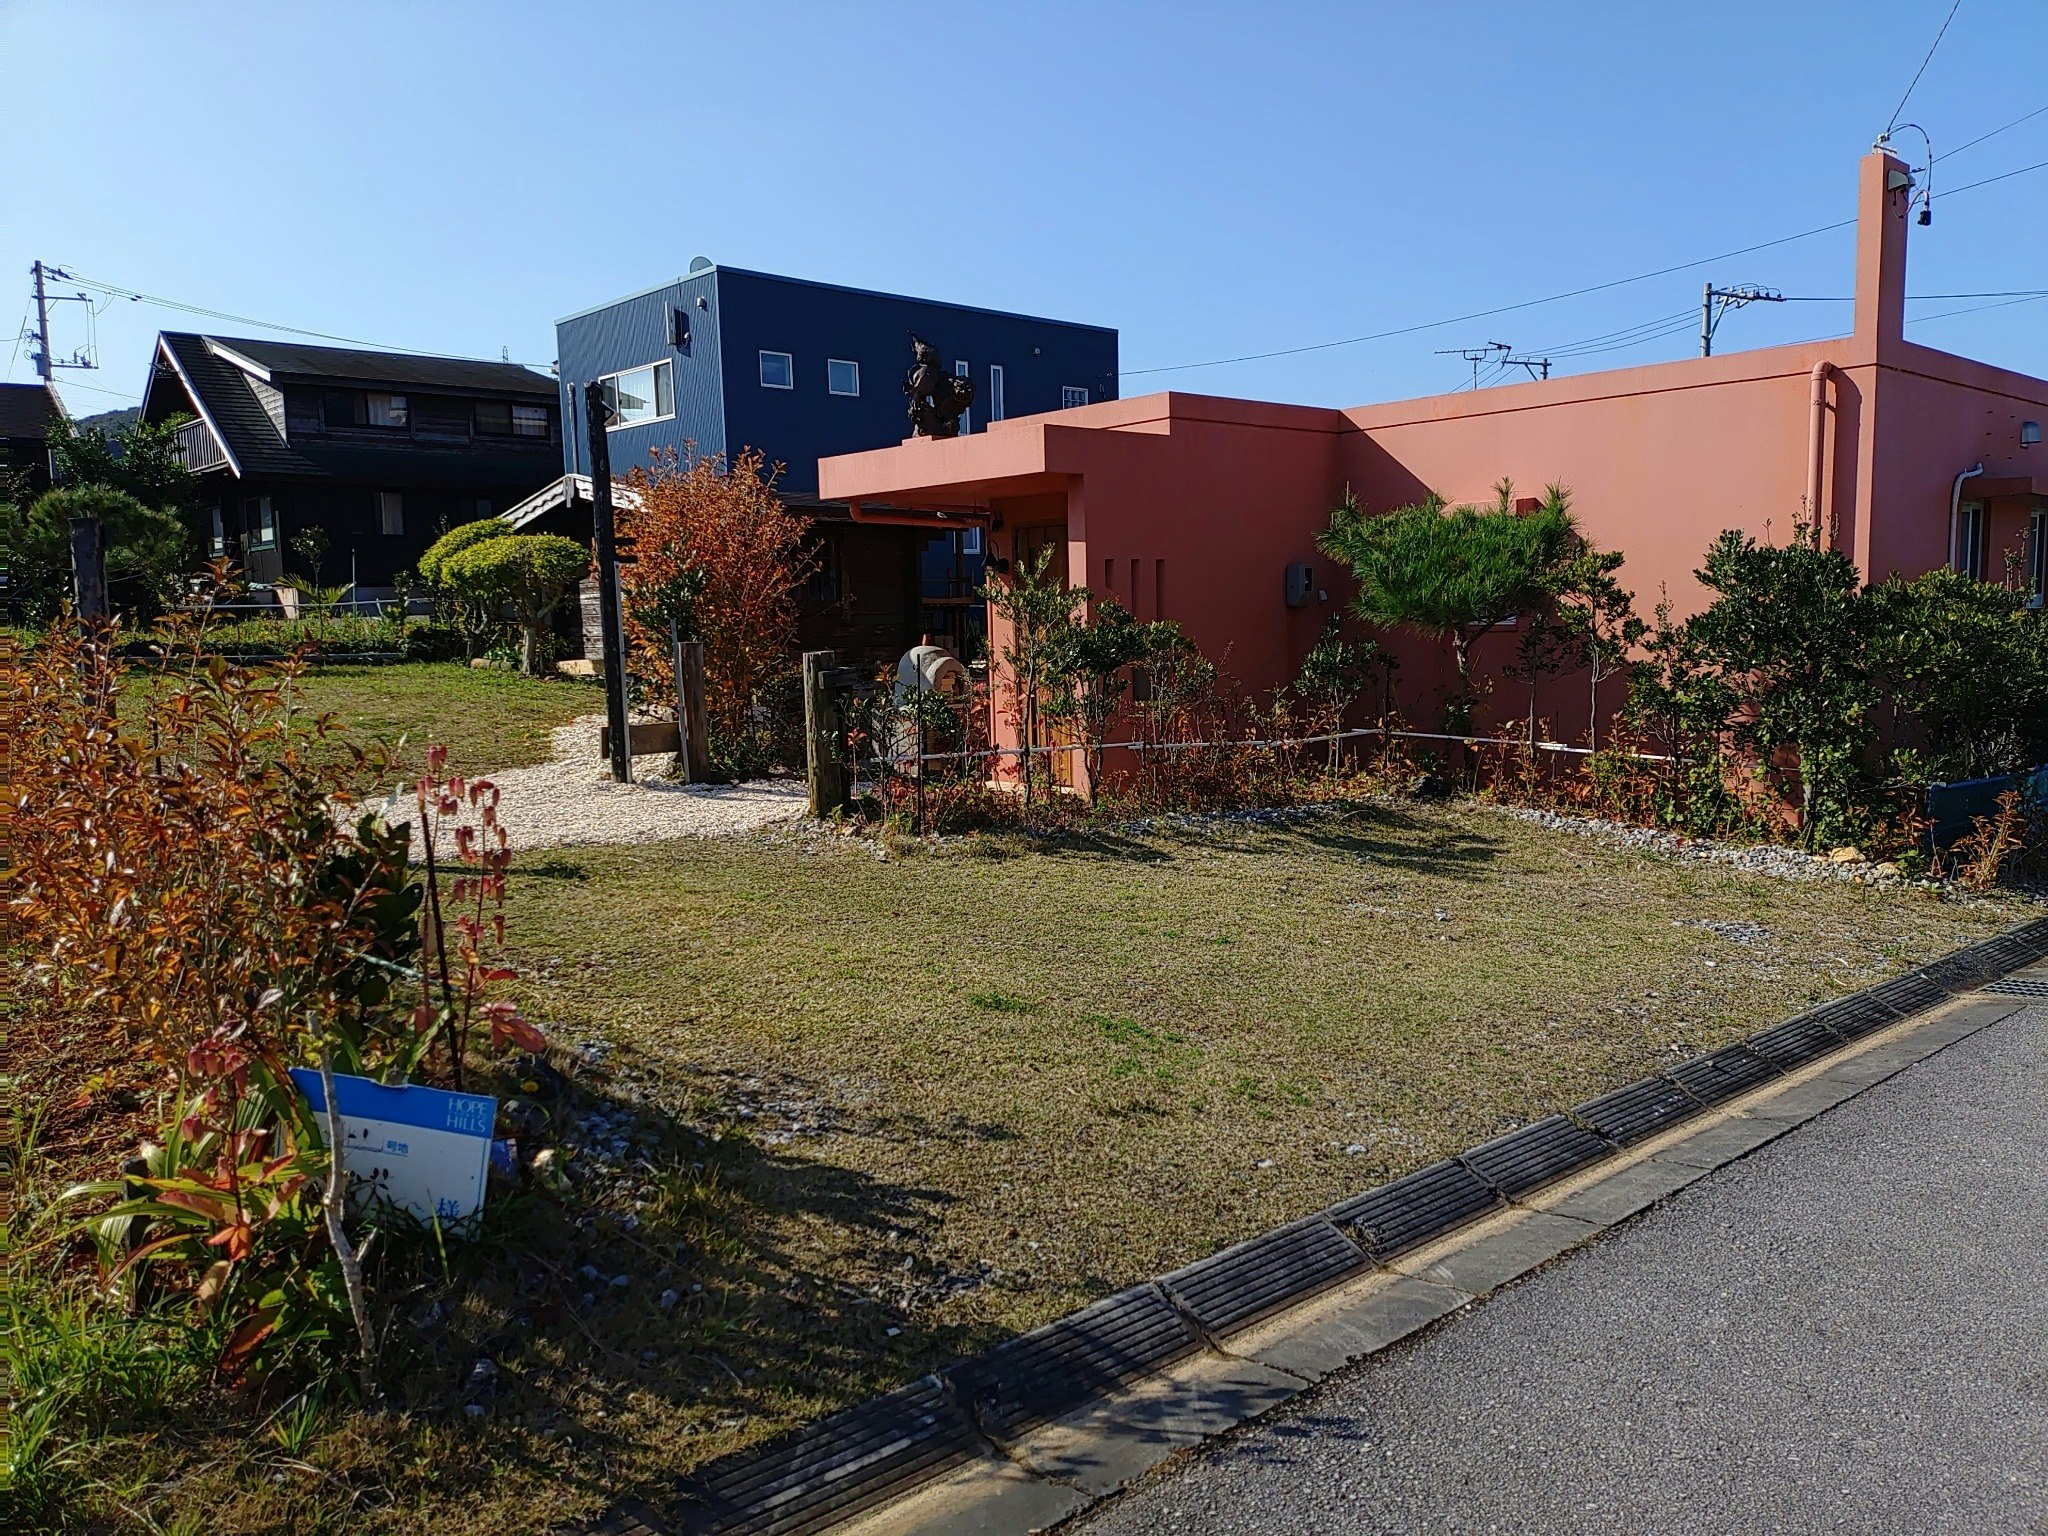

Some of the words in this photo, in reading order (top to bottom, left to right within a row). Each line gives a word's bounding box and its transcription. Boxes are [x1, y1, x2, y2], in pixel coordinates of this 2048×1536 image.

[448, 1097, 488, 1114] HOPE
[446, 1114, 486, 1132] HILLS
[387, 1140, 409, 1153] 号地
[437, 1198, 460, 1222] 様
